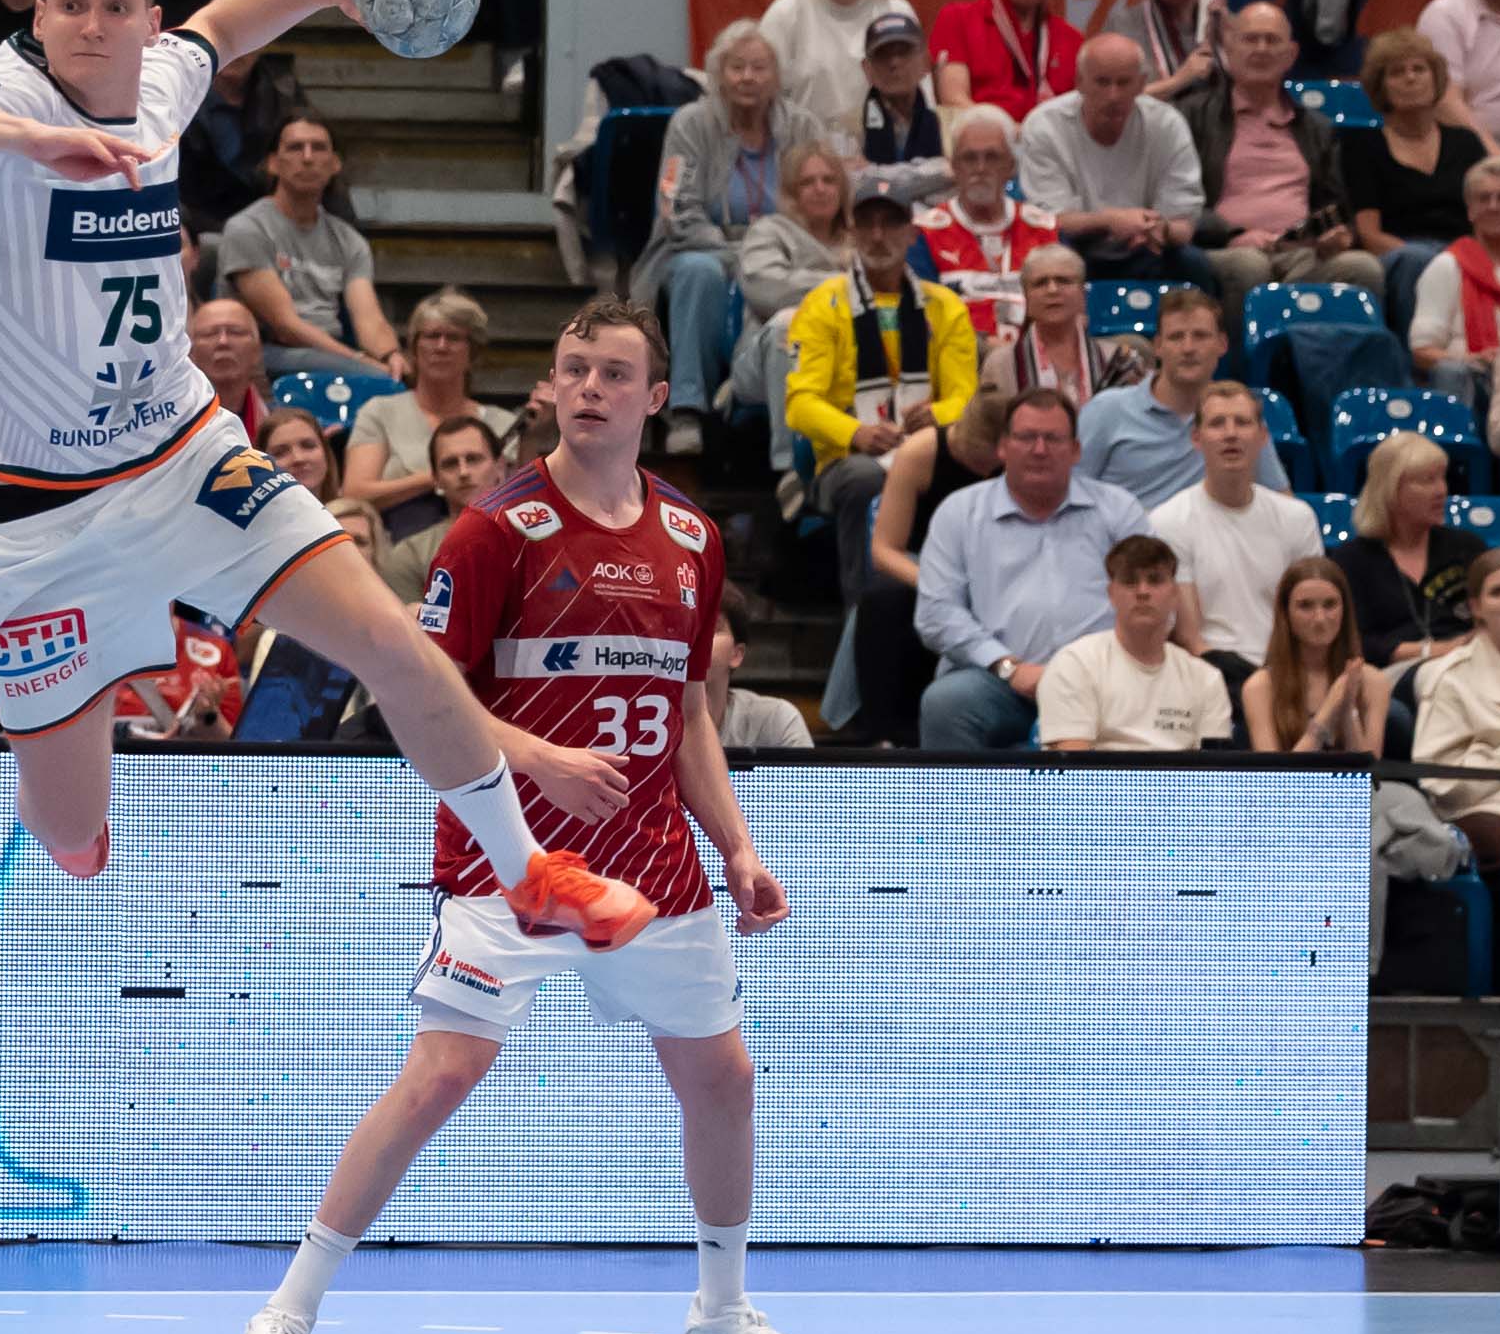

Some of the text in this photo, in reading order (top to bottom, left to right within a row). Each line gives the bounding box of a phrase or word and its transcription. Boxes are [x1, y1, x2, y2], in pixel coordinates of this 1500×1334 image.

[71, 205, 181, 236] Buderus
[99, 274, 163, 347] 75
[49, 400, 179, 447] BUNDEWEHR
[517, 505, 550, 530] Dole
[668, 512, 702, 539] Dole
[591, 563, 633, 582] AOK
[4, 651, 89, 699] ENERGIE
[592, 694, 671, 756] 33
[450, 971, 501, 998] HAMBURG
